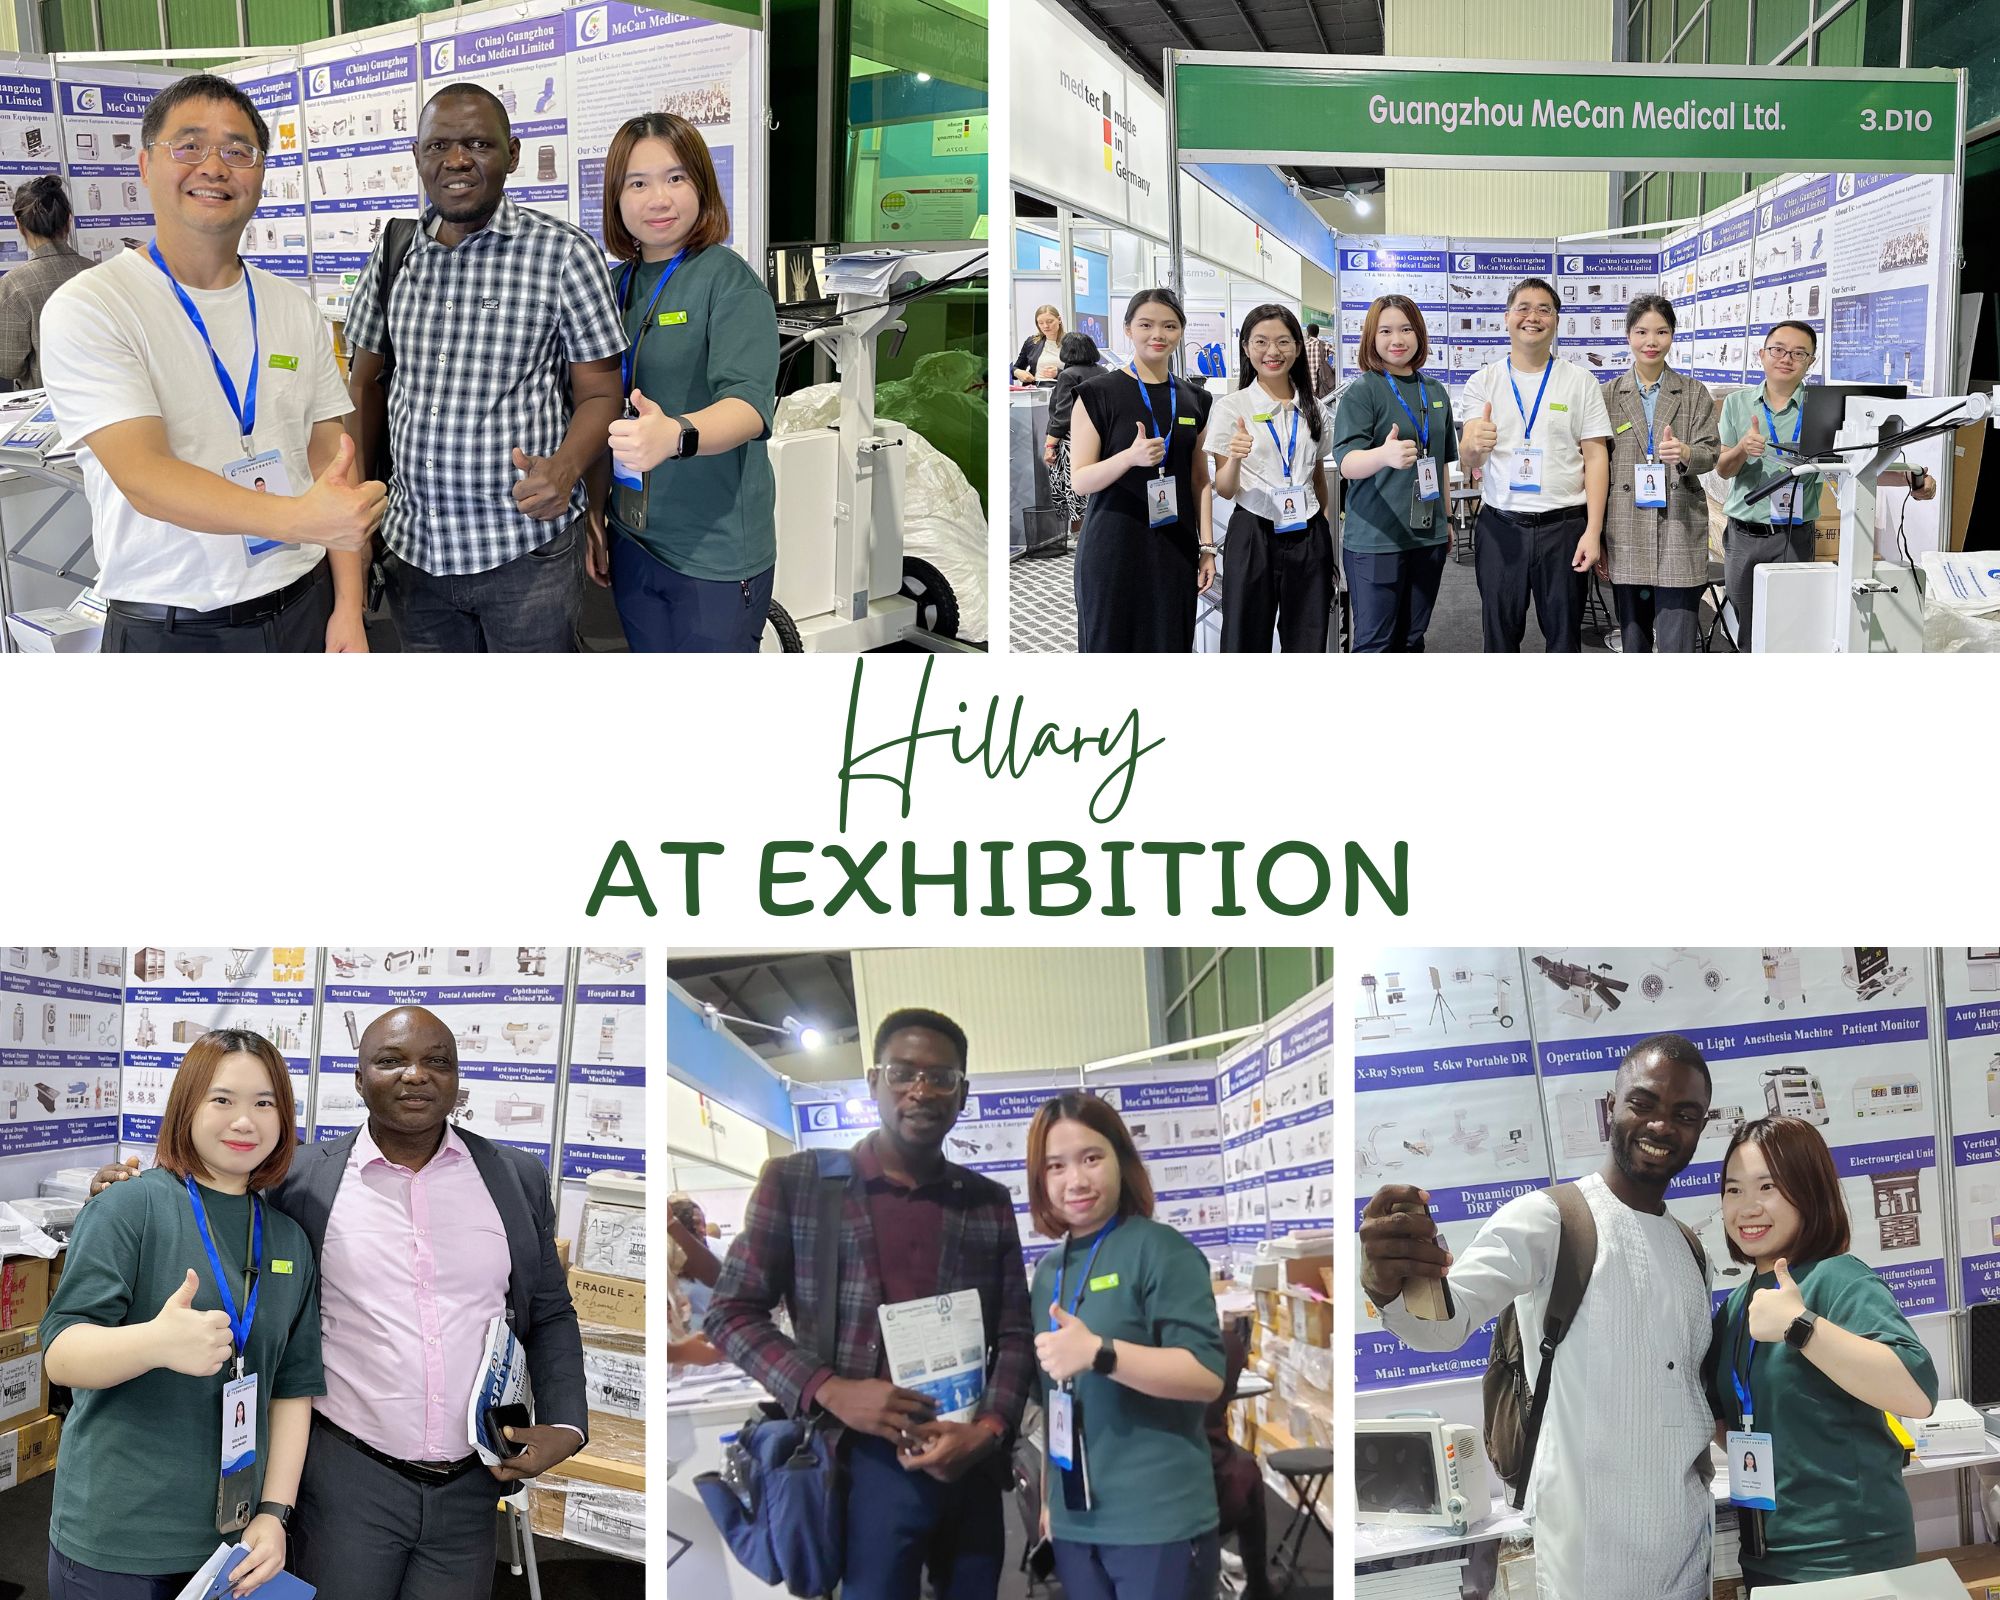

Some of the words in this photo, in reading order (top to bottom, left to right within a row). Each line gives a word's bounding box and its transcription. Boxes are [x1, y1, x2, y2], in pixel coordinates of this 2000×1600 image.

[612, 20, 646, 36] MeCan
[475, 34, 505, 51] (China)
[506, 26, 555, 43] Guangzhou
[458, 53, 486, 66] MeCan
[488, 47, 519, 61] Medical
[521, 39, 555, 54] Limited
[345, 63, 370, 77] (China)
[371, 56, 408, 70] Guangzhou
[576, 55, 597, 66] About
[333, 78, 355, 91] MeCan
[355, 74, 380, 86] Medical
[381, 68, 408, 82] Limited
[262, 80, 291, 94] Guangzhou
[1060, 68, 1101, 112] medtec
[6, 95, 42, 107] Limited
[271, 92, 292, 104] Limited
[106, 103, 138, 113] MeCan
[1369, 94, 1523, 132] Guangzhou
[1531, 100, 1624, 128] MeCan
[1631, 101, 1735, 131] Medical
[1743, 102, 1786, 131] Ltd.
[1859, 108, 1932, 132] 3.D10
[1114, 110, 1137, 138] made
[1114, 132, 1123, 153] in
[577, 146, 591, 156] Our
[1115, 160, 1151, 197] Germany
[1407, 255, 1440, 263] Guangzhou
[1491, 257, 1513, 265] (China)
[1513, 257, 1546, 267] Guangzhou
[1621, 258, 1652, 266] Guangzhou
[137, 988, 159, 997] Mortuary
[331, 989, 352, 997] Dental
[352, 990, 371, 998] Chair
[388, 989, 409, 997] Dental
[409, 989, 428, 998] X-ray
[438, 991, 461, 999] Dental
[461, 990, 496, 999] Autoclave
[503, 994, 535, 1002] Combined
[536, 994, 556, 1002] Table
[512, 987, 550, 996] Ophthalmic
[587, 989, 619, 999] Hospital
[620, 989, 636, 999] Bed
[394, 996, 421, 1004] Machine
[1955, 1009, 1976, 1022] Auto
[1842, 1021, 1878, 1036] Patient
[1880, 1017, 1921, 1033] Monitor
[1743, 1031, 1792, 1047] Anesthesia
[1795, 1025, 1834, 1041] Machine
[1707, 1036, 1736, 1052] Light
[1433, 1058, 1463, 1072] 5.6kw
[1466, 1054, 1509, 1069] Portable
[1511, 1052, 1528, 1064] DR
[1546, 1048, 1603, 1065] Operation
[498, 1073, 519, 1082] Oxygen
[519, 1074, 546, 1082] Chamber
[522, 1067, 553, 1076] Hyperbaric
[581, 1067, 625, 1078] Hemodialysis
[1357, 1067, 1388, 1081] X-Ray
[1390, 1063, 1424, 1077] System
[588, 1074, 617, 1084] Machine
[1140, 1087, 1167, 1097] (China)
[1168, 1085, 1208, 1095] Guangzhou
[999, 1095, 1028, 1106] (China)
[983, 1106, 1010, 1117] MeCan
[1963, 1137, 1997, 1150] Vertical
[569, 1149, 590, 1160] Infant
[592, 1151, 626, 1162] Incubator
[1850, 1151, 1914, 1167] Electrosurgical
[1916, 1148, 1934, 1159] Unit
[1966, 1151, 1993, 1162] Steam
[1670, 1173, 1711, 1189] Medical
[1461, 1183, 1538, 1203] Dynamic(DR)
[1467, 1201, 1493, 1215] DRF
[1880, 1265, 1933, 1280] ltifunctional
[1971, 1260, 2000, 1272] Medica
[1984, 1272, 1992, 1280] &
[575, 1279, 625, 1298] FRAGILE
[1888, 1280, 1906, 1291] Saw
[1907, 1276, 1937, 1289] System
[1373, 1341, 1397, 1355] Dry
[1375, 1365, 1406, 1381] Mail:
